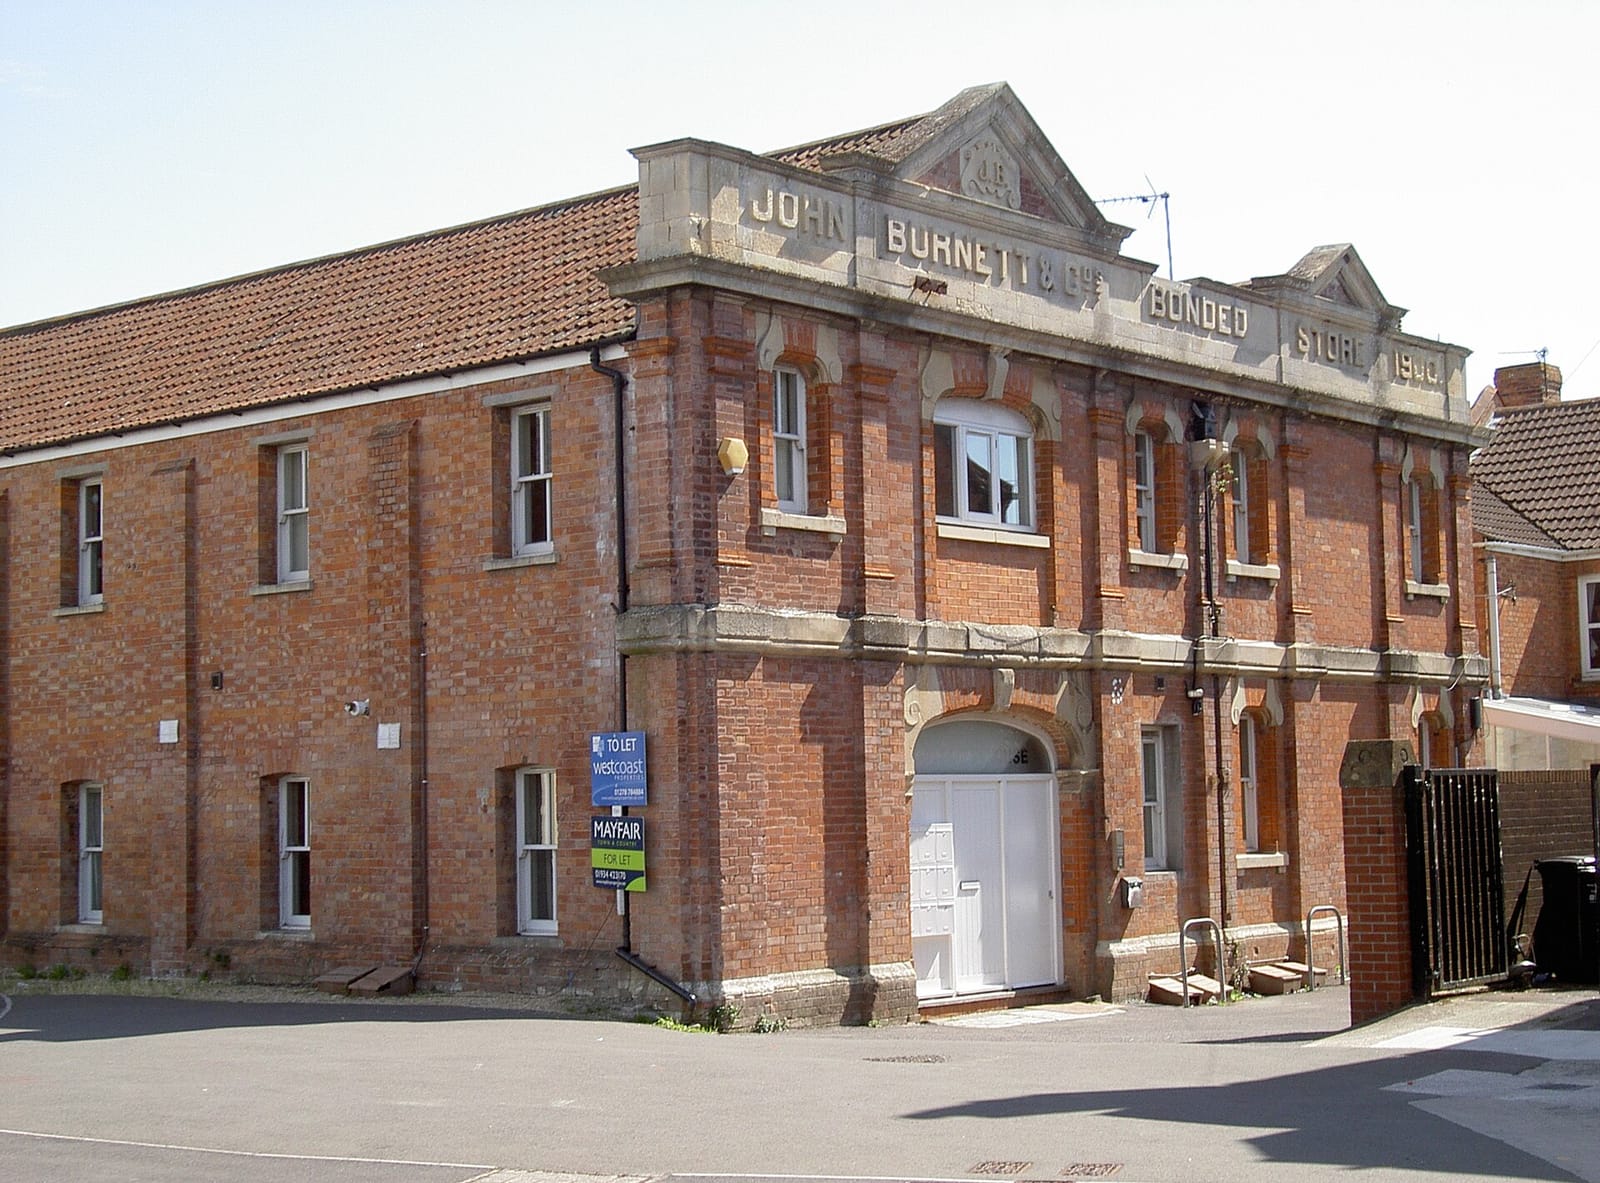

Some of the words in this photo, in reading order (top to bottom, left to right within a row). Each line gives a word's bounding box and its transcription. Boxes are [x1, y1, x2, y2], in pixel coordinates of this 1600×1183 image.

[751, 188, 844, 241] JOHN
[887, 218, 1031, 285] BURNETT
[1039, 256, 1054, 291] &
[1150, 283, 1248, 338] BONDED
[1296, 322, 1364, 369] STORE
[607, 738, 620, 752] TO
[620, 738, 637, 752] LET
[593, 758, 644, 775] westcoast
[594, 820, 641, 840] MAYFAIR
[603, 853, 618, 865] FOR
[618, 854, 631, 866] LET
